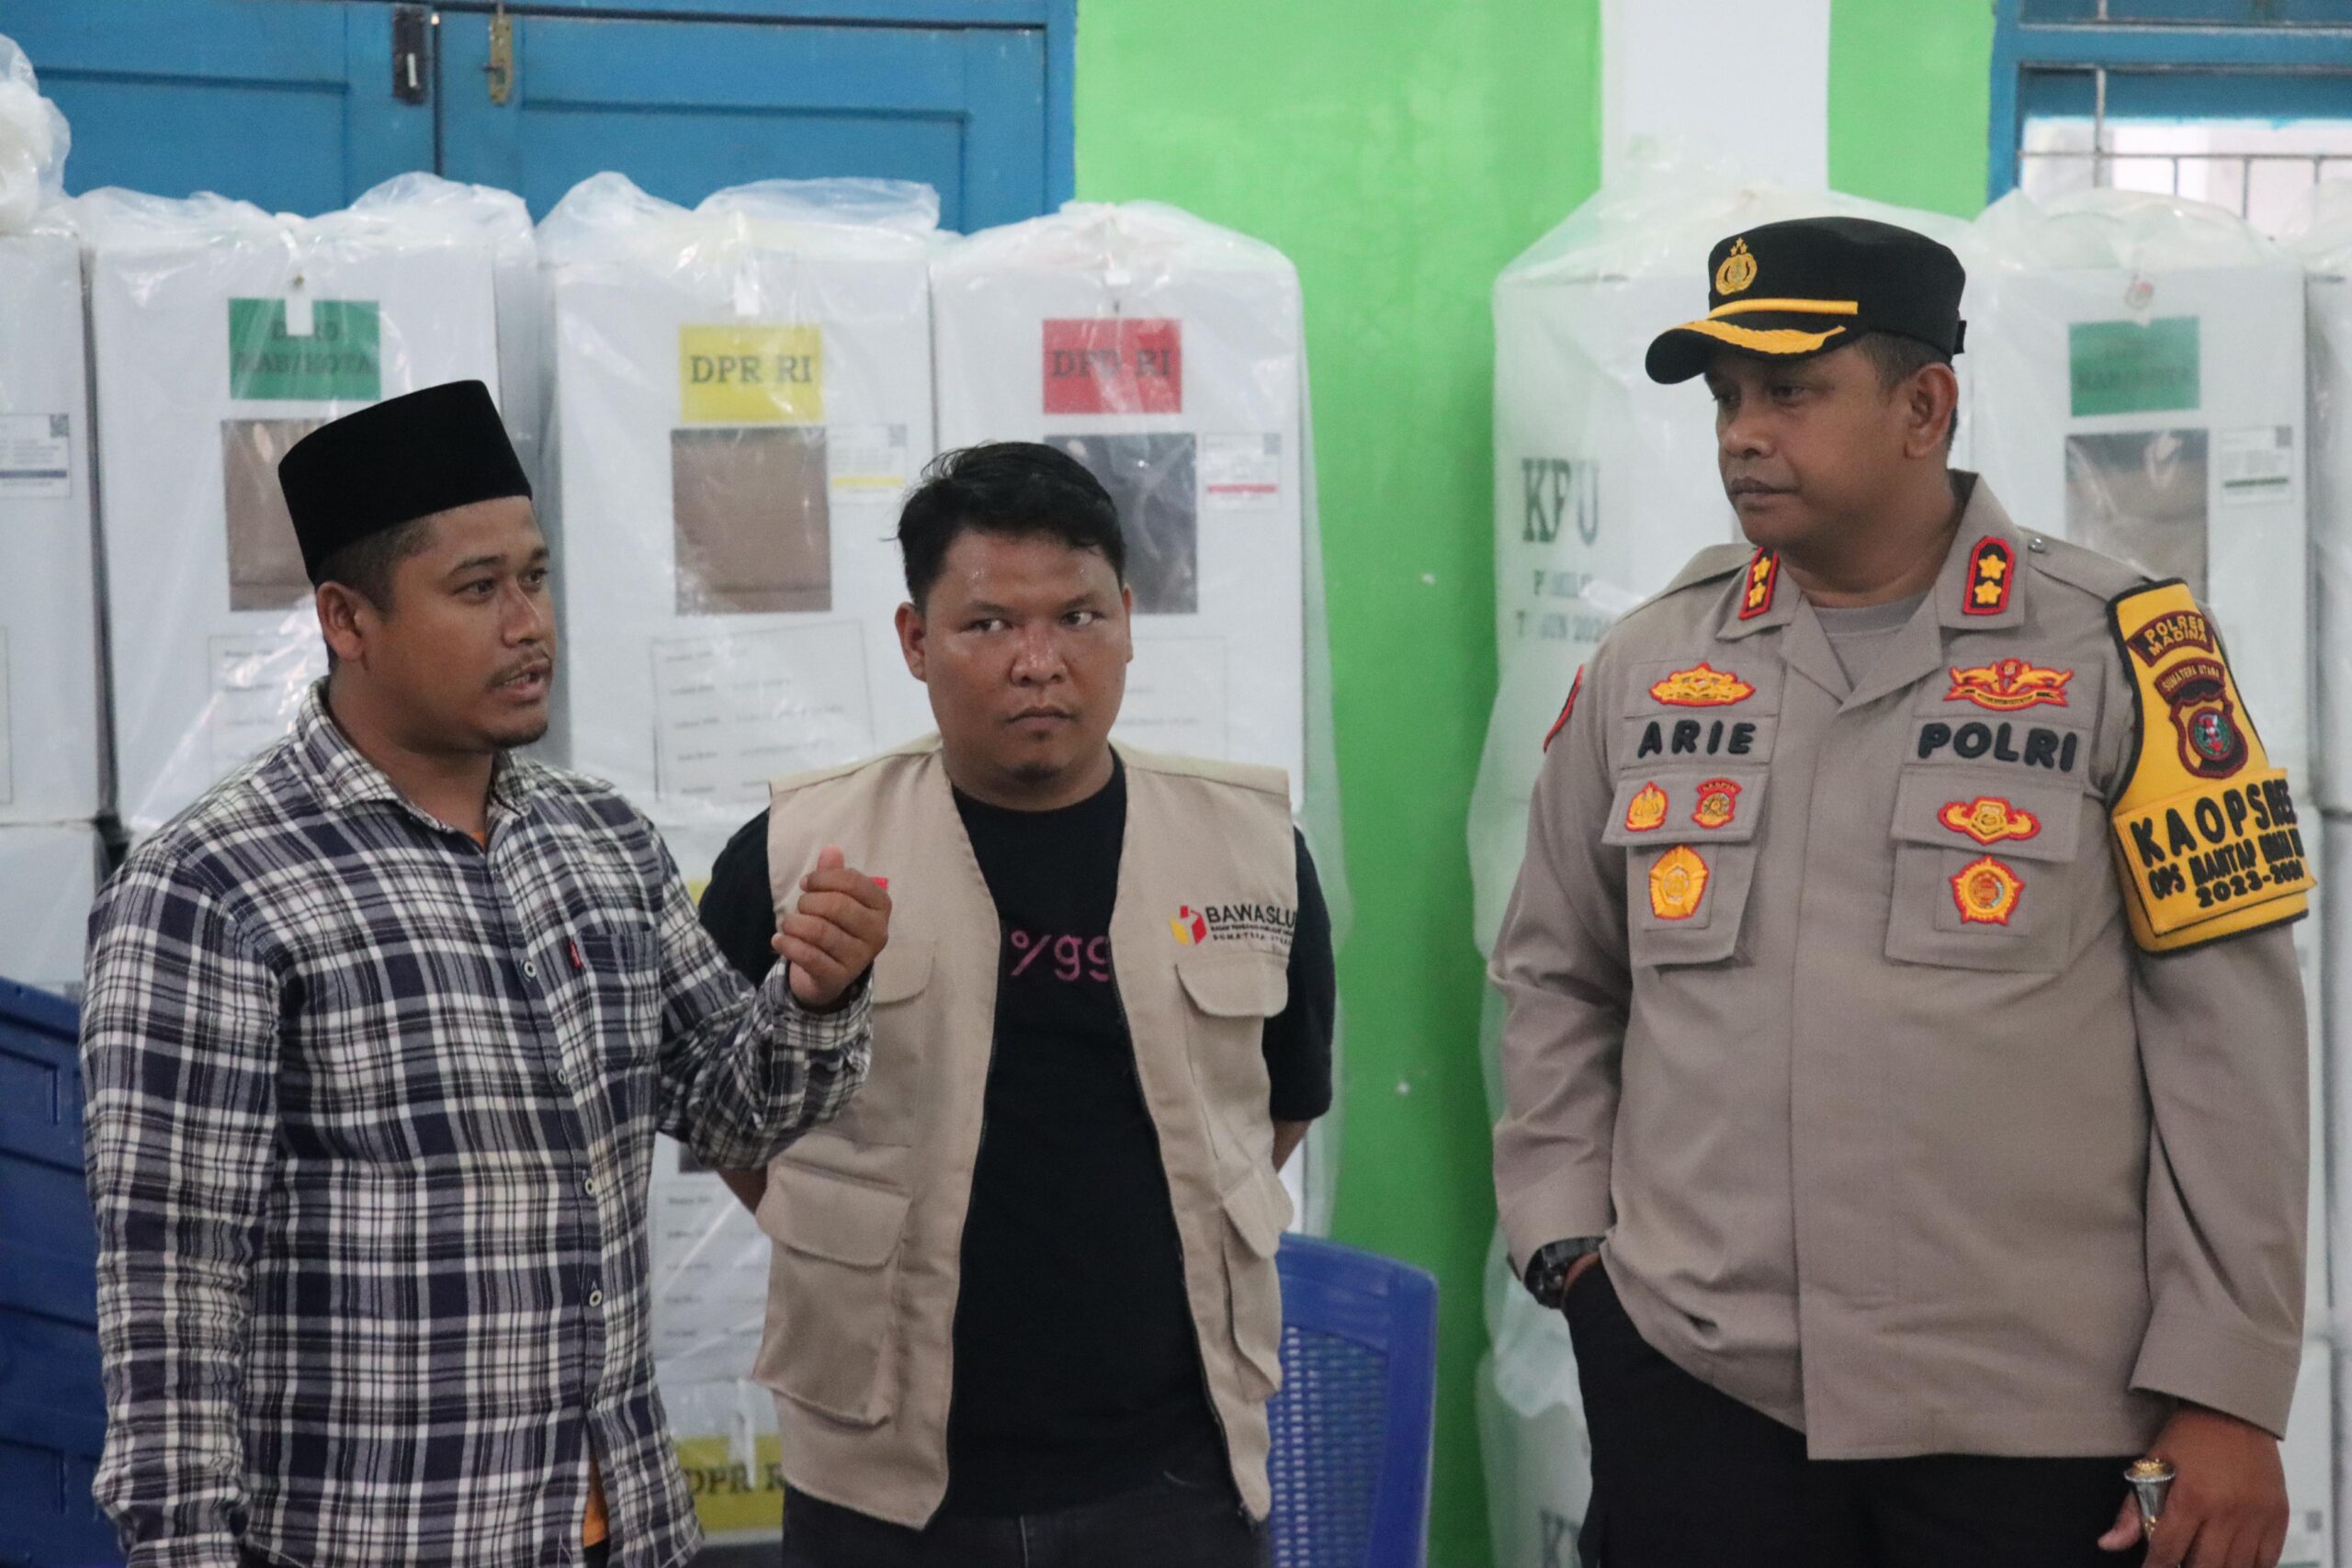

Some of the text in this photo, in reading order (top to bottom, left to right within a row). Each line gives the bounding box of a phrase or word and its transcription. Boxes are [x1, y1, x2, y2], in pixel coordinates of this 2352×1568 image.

[690, 355, 812, 384] DPR RI
[1135, 348, 1170, 378] RI
[1521, 457, 1600, 547] KPU
[2143, 615, 2206, 645] POLRES
[2148, 626, 2207, 657] MADINA
[1637, 719, 1757, 759] ARIE
[1917, 721, 2078, 773] POLRI
[2147, 862, 2187, 901] OPS
[1204, 904, 1297, 929] BAWASLU
